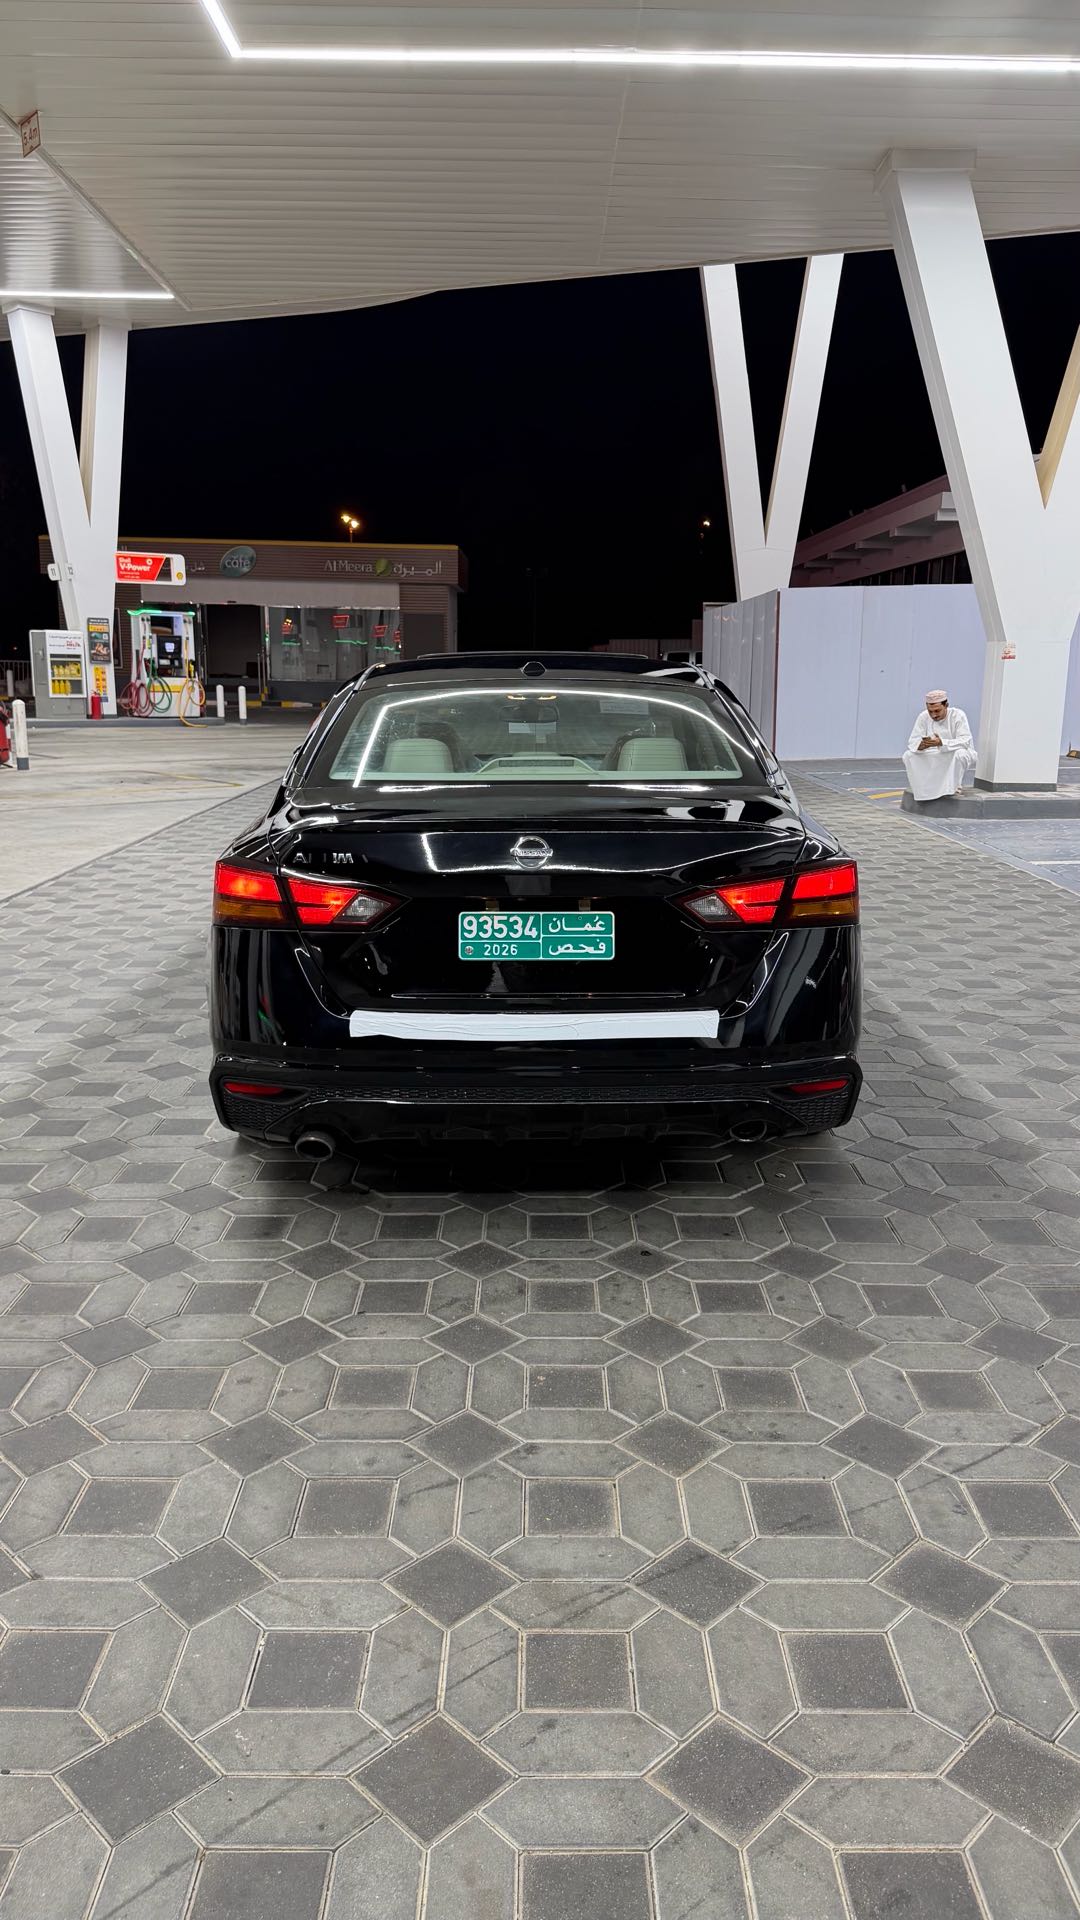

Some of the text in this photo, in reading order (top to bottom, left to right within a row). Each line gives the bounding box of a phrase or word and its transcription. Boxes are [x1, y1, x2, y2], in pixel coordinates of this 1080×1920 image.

[119, 562, 152, 572] V-Power
[338, 560, 373, 572] Meera
[463, 915, 538, 939] 93534
[483, 944, 518, 956] 2026
[548, 938, 606, 956] فحص
